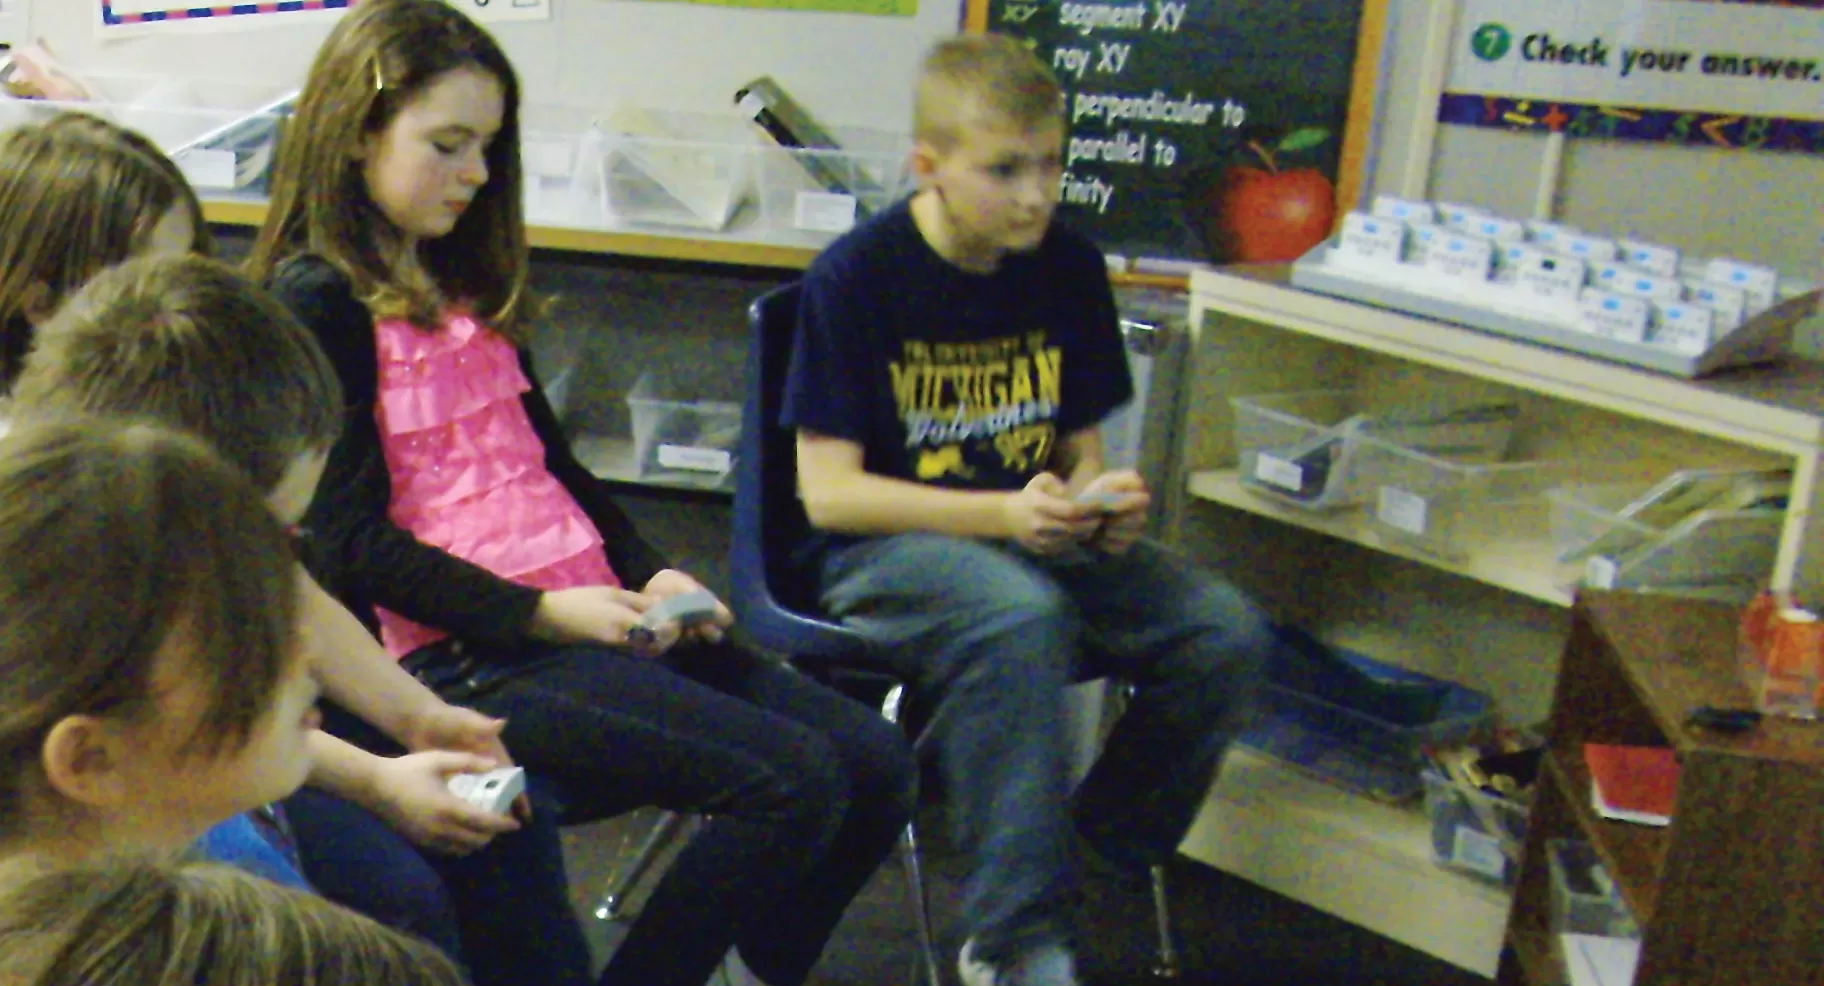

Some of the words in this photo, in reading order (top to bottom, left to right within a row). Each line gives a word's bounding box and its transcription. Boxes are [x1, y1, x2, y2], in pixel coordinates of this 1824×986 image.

[1058, 2, 1147, 36] segment
[1152, 1, 1187, 33] XY
[1053, 45, 1091, 79] ray
[1096, 41, 1132, 73] XY
[1521, 33, 1609, 66] Check
[1618, 47, 1690, 77] your
[1700, 52, 1822, 82] answer.
[1072, 89, 1215, 126] perpendicular
[1222, 98, 1247, 129] to
[1067, 131, 1148, 166] parallel
[1154, 138, 1178, 167] to
[888, 347, 1062, 424] MICHIGAN
